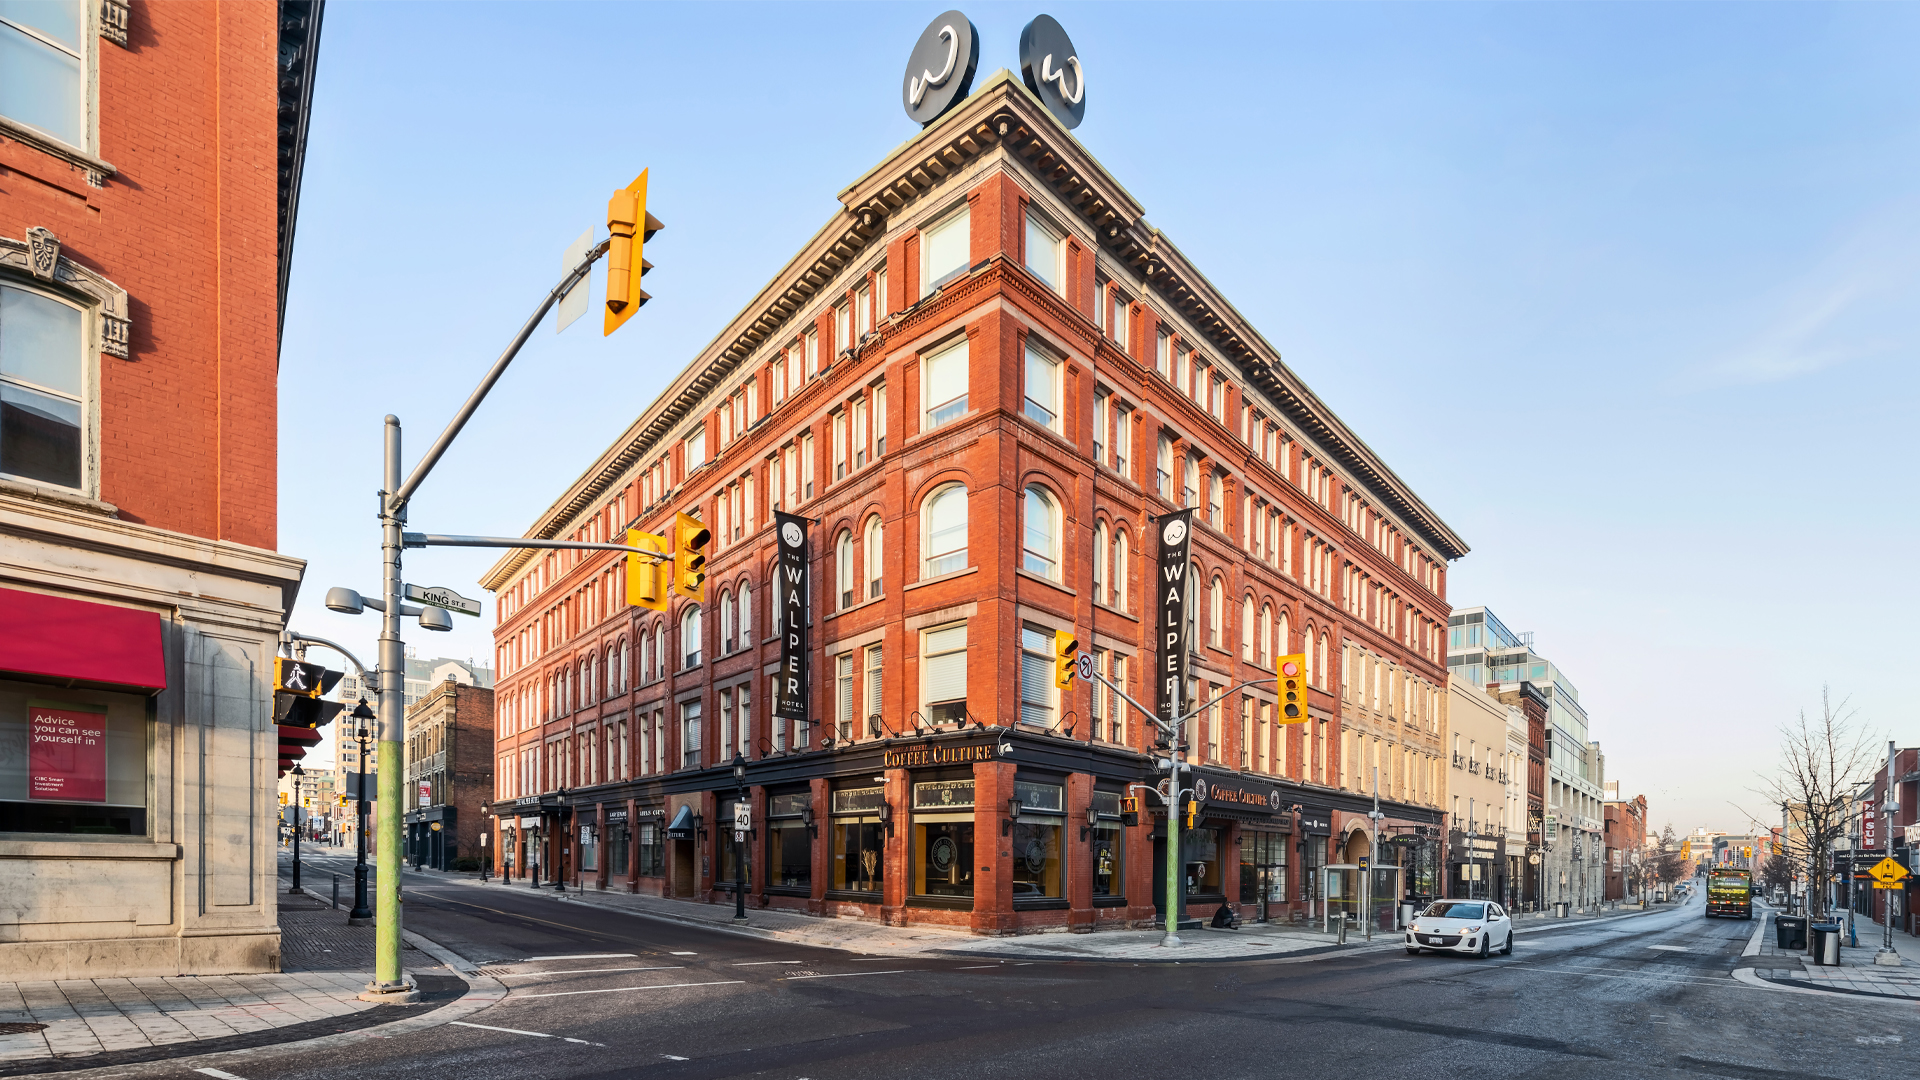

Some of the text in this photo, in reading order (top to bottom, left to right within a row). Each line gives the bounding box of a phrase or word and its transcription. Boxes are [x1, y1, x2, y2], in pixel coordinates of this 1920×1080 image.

[787, 553, 800, 562] THE
[423, 591, 449, 605] KING
[785, 565, 802, 695] WALPER
[782, 700, 804, 708] HOTEL
[34, 714, 75, 726] Advice
[34, 734, 95, 745] yourself in
[884, 745, 992, 767] COFFEE CULTURE
[1211, 784, 1238, 802] COFFEE
[1239, 788, 1267, 806] CULTURE
[736, 814, 749, 826] 40
[1866, 822, 1874, 845] SUB
